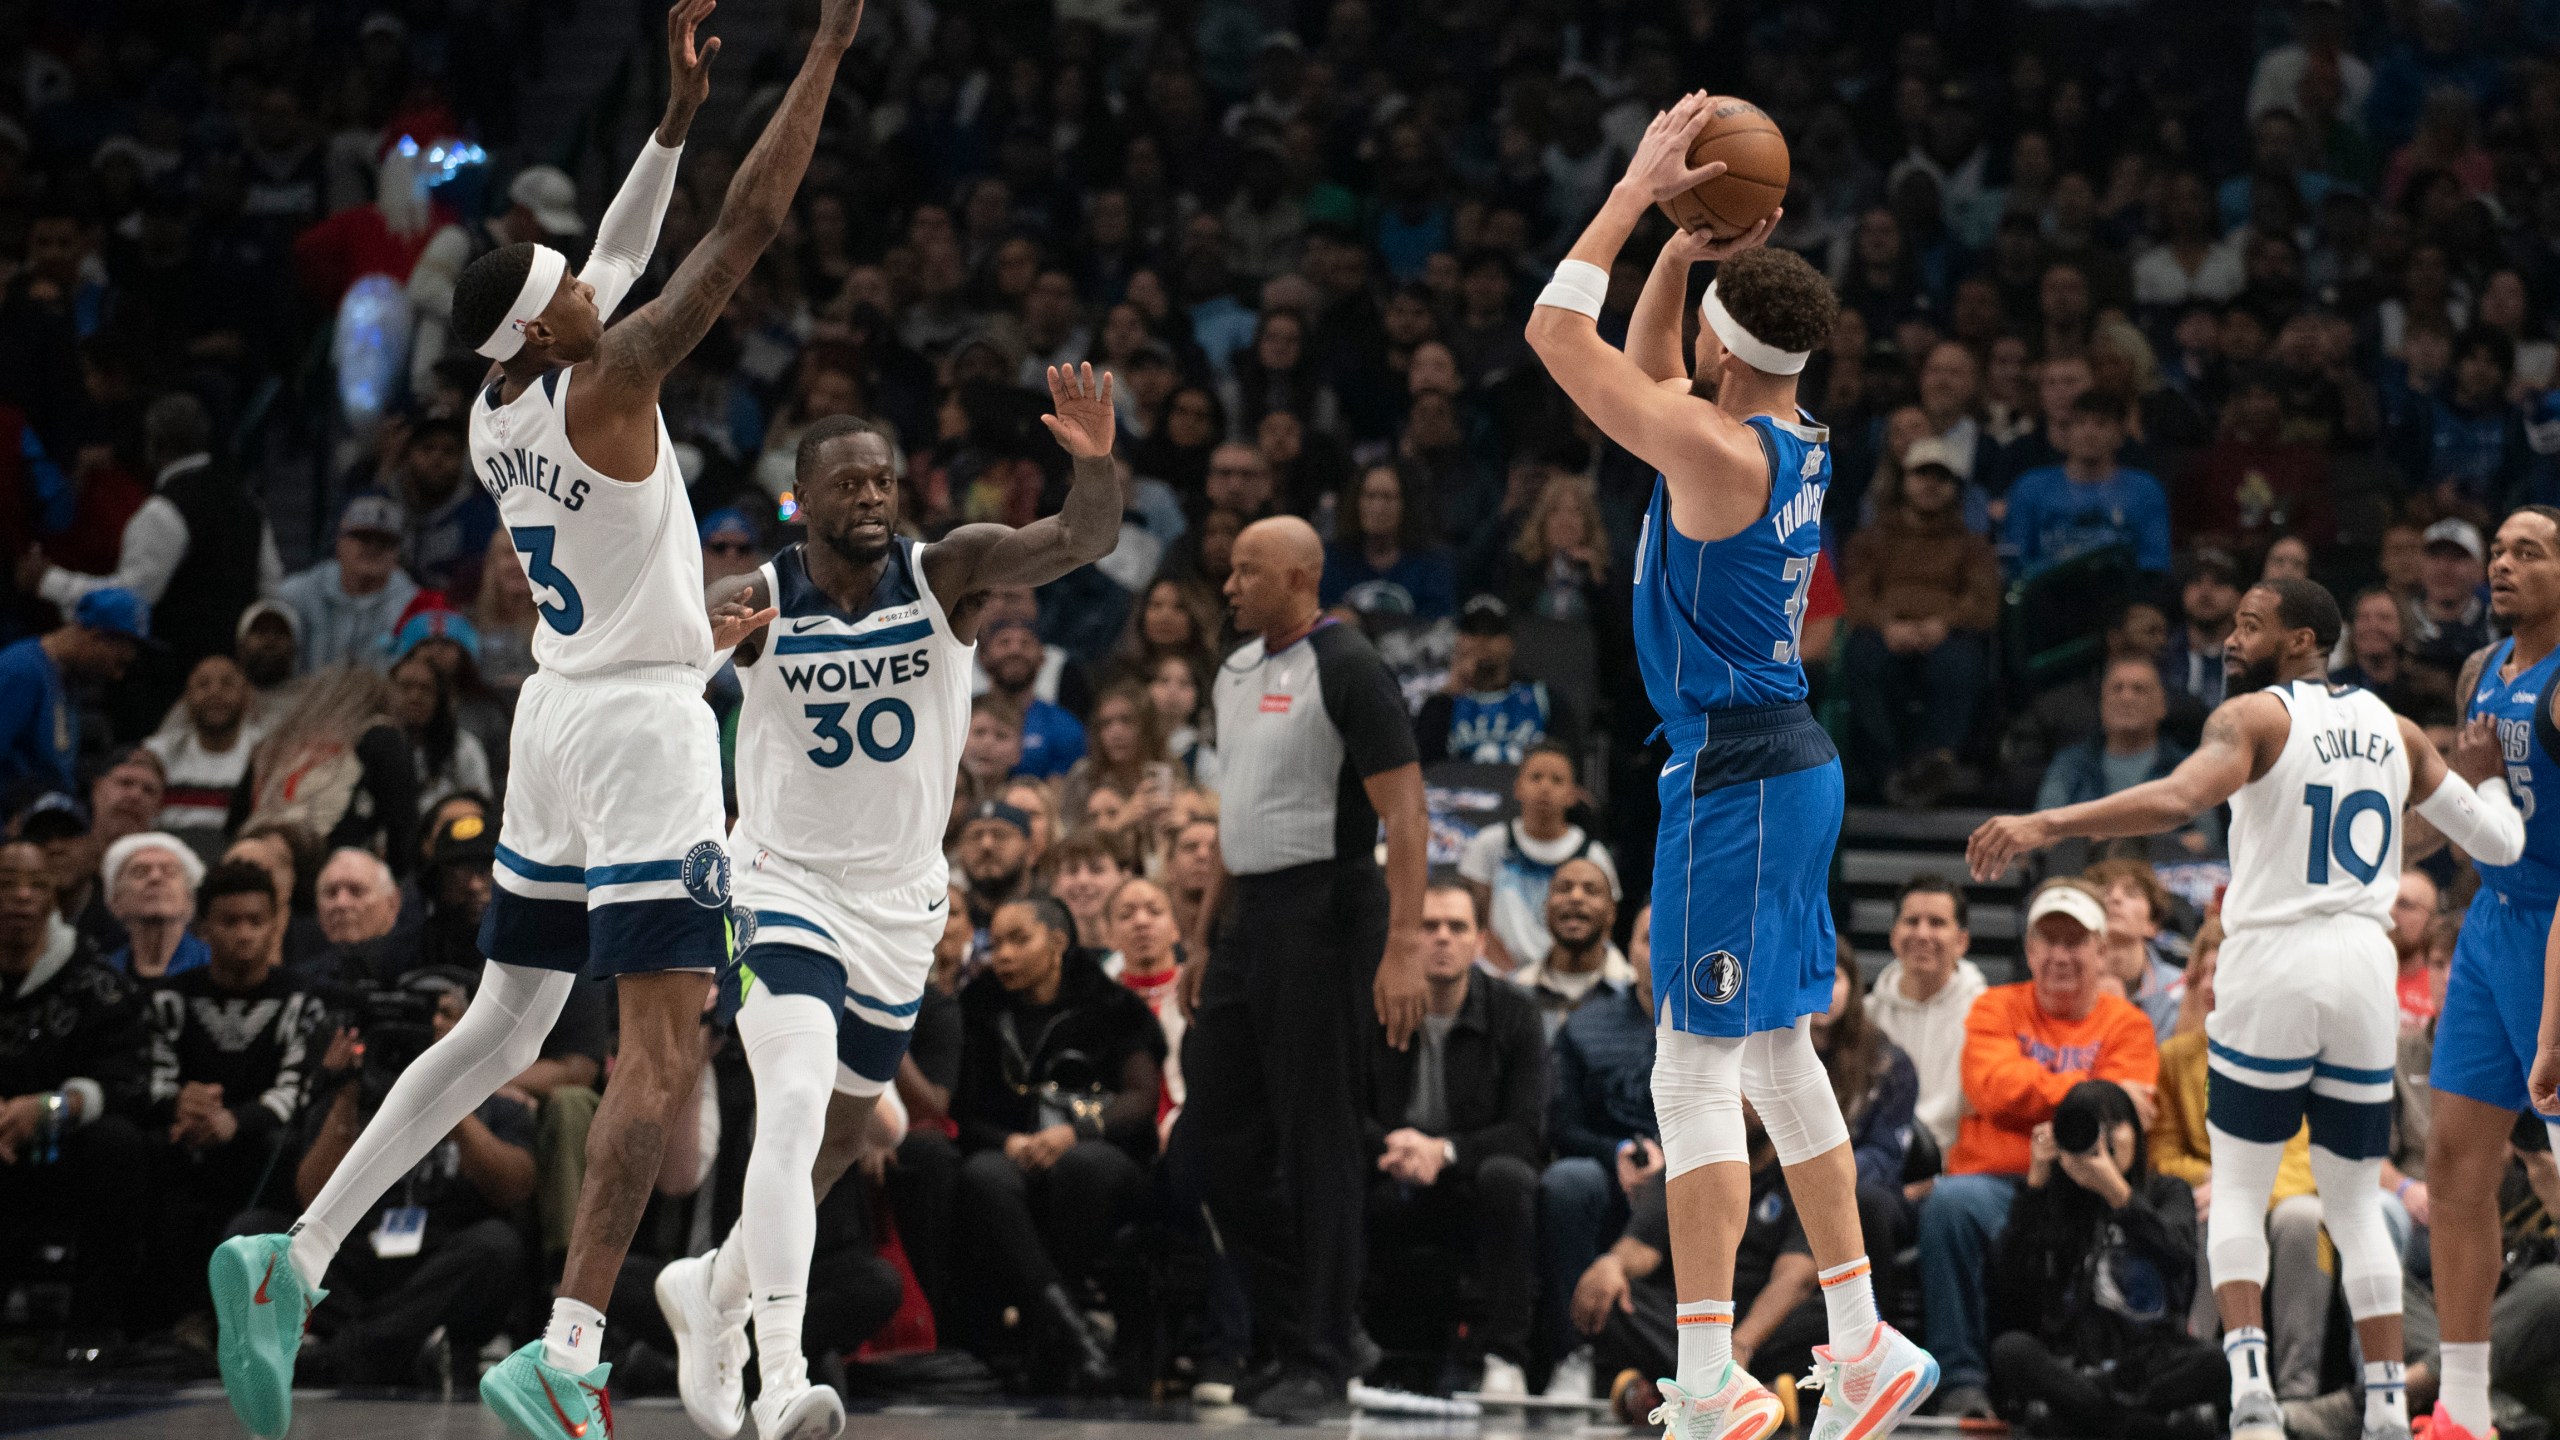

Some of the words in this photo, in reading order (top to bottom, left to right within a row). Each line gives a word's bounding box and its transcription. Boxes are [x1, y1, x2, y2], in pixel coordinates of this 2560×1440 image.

[510, 525, 584, 636] 3
[884, 608, 919, 622] sezzle
[778, 649, 930, 694] WOLVES
[804, 697, 915, 769] 30
[2303, 783, 2392, 887] 10
[684, 843, 707, 886] MINNESOTA
